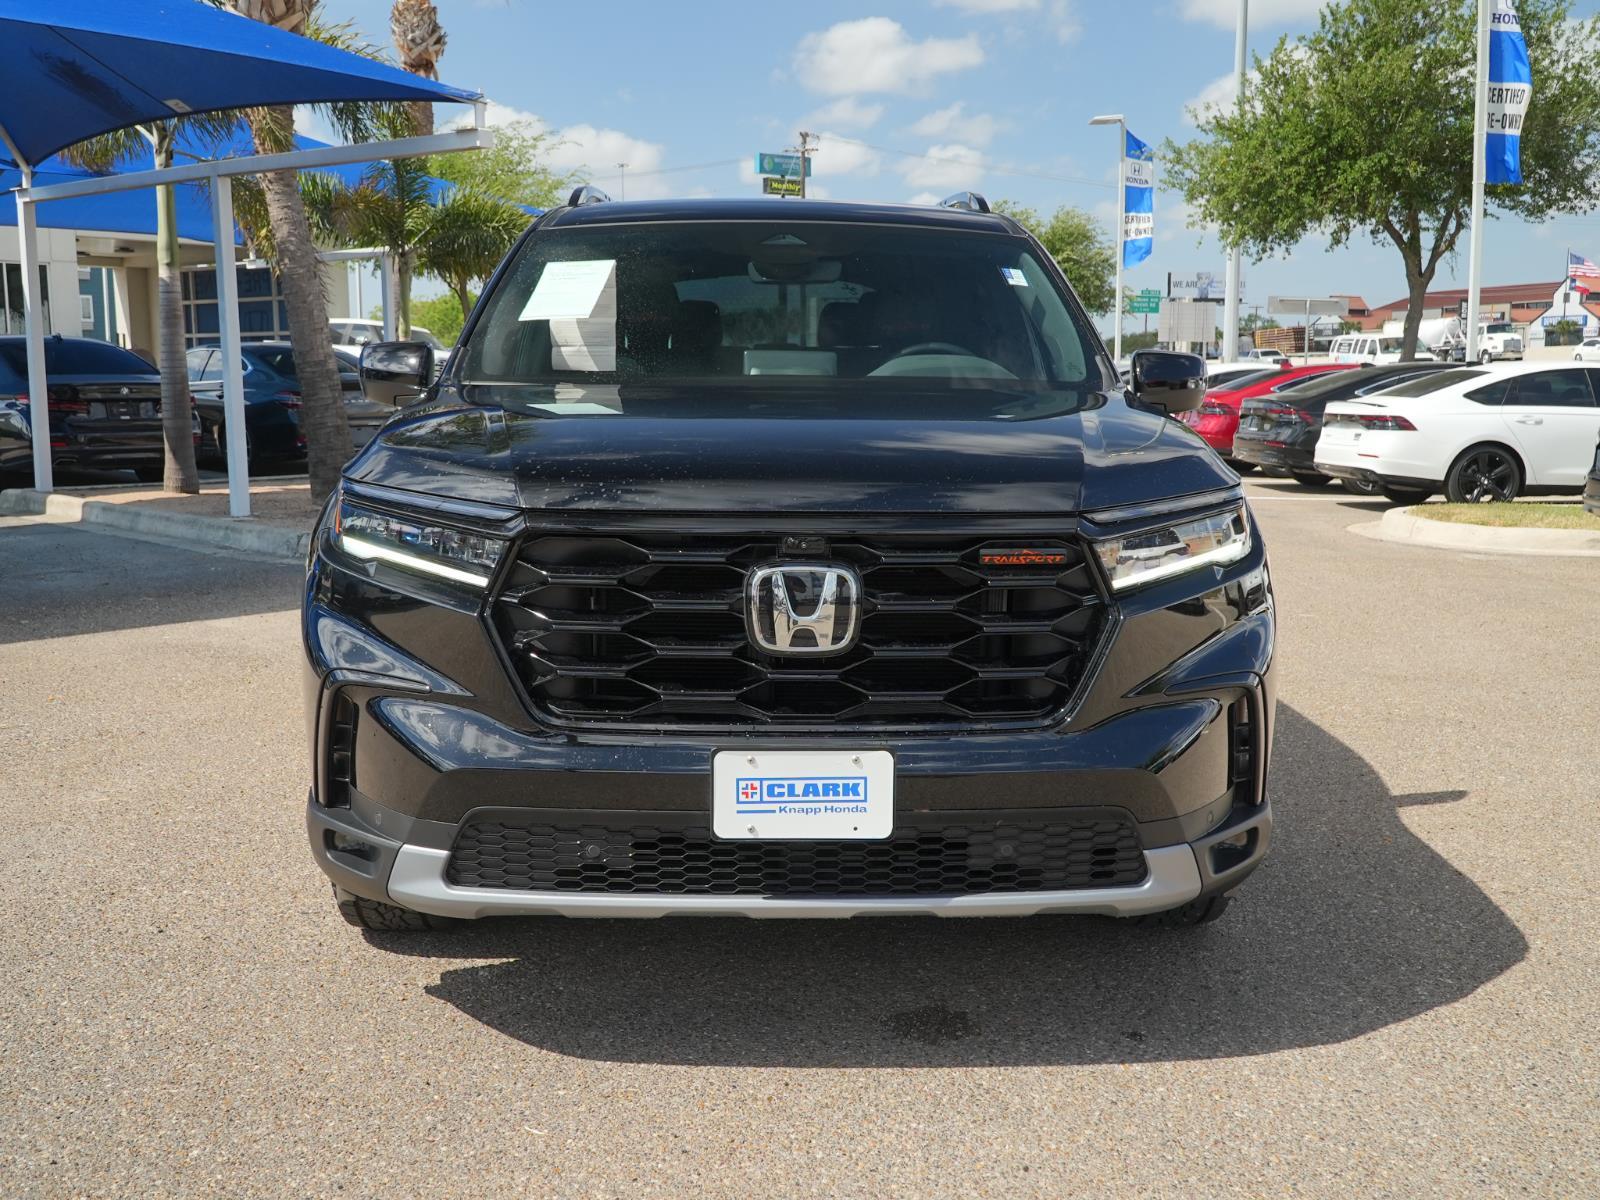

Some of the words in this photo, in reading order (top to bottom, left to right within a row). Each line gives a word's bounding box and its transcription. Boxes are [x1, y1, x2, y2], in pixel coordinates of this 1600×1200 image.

[1172, 280, 1184, 289] WE
[981, 554, 1065, 565] TRAILSPORT
[766, 782, 861, 798] CLARK
[778, 805, 822, 816] Knapp
[824, 804, 867, 814] Honda
